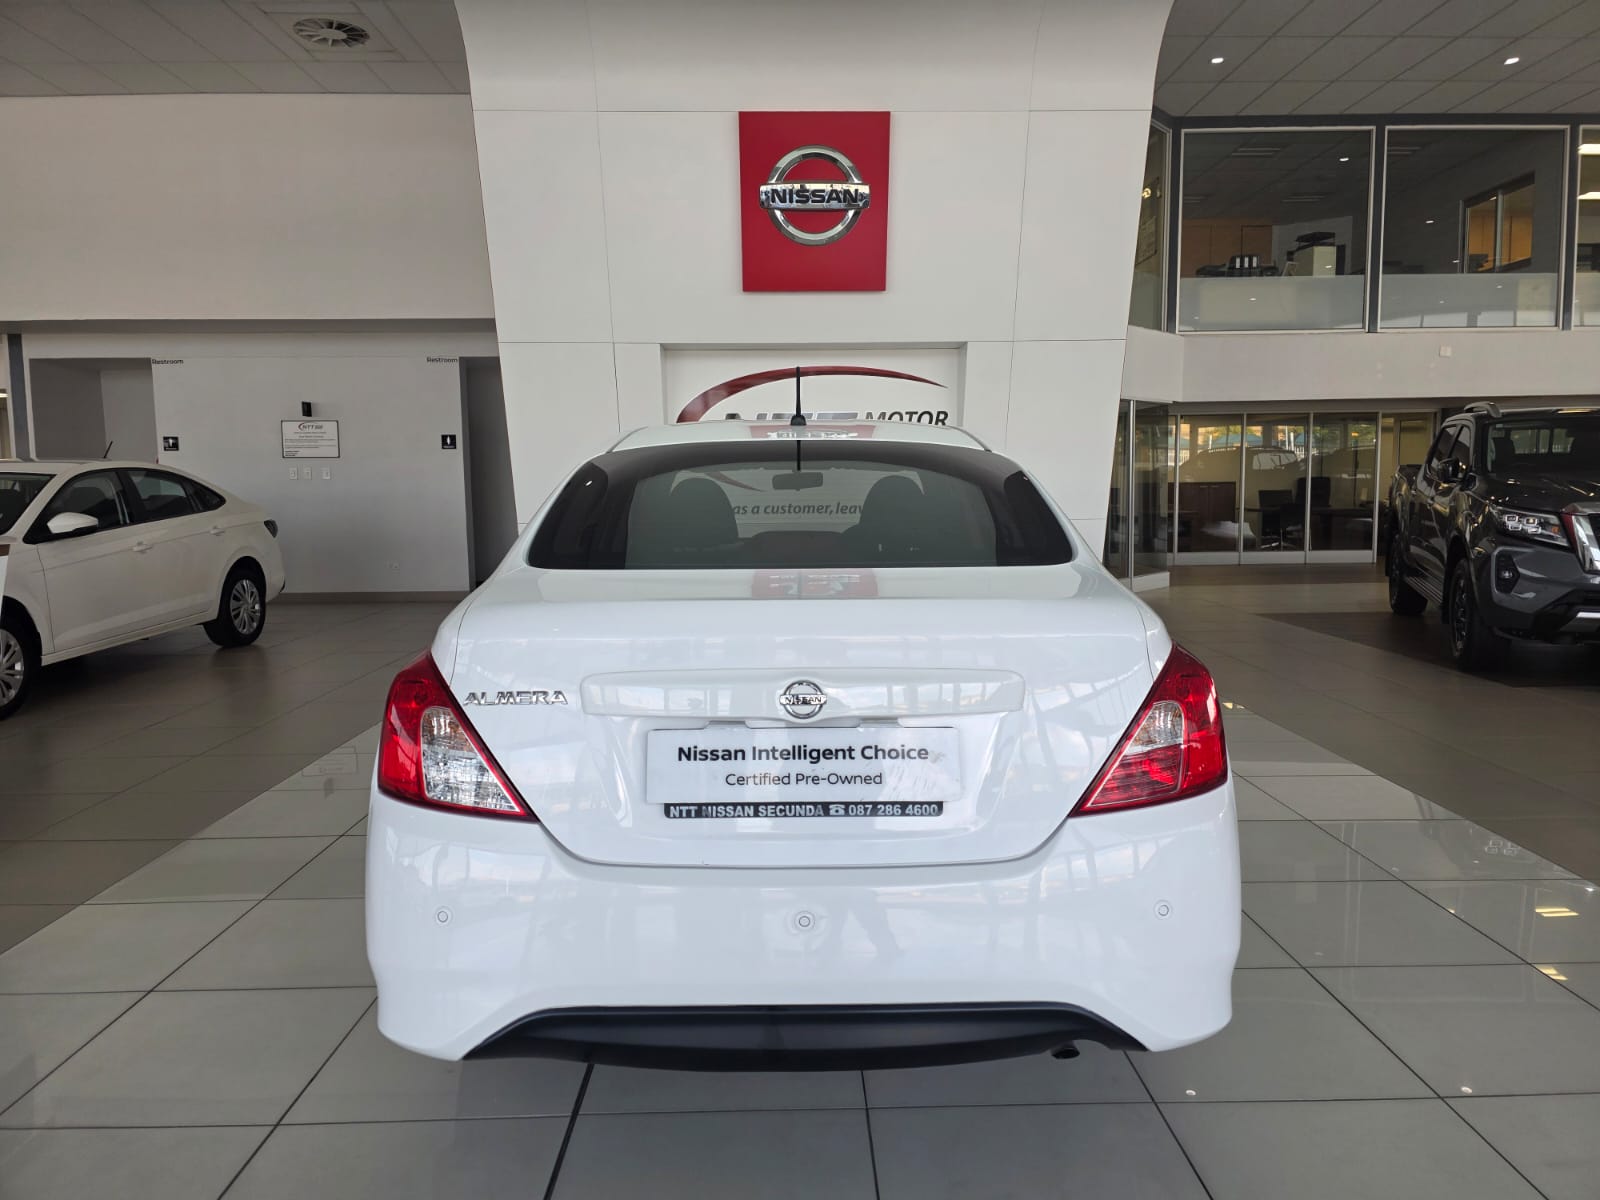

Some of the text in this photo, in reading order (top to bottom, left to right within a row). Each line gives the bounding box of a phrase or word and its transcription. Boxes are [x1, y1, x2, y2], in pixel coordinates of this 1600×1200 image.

[770, 188, 859, 204] NISSAN
[751, 504, 761, 515] a
[764, 503, 833, 517] customer,
[463, 690, 569, 706] ALMERA
[785, 695, 822, 705] NISSAN
[678, 744, 929, 764] Nissan Intelligent Choice
[725, 772, 883, 786] Certified Pre-Owned
[669, 804, 938, 818] NTT NISSAN SECUNDA 087 286 4600
